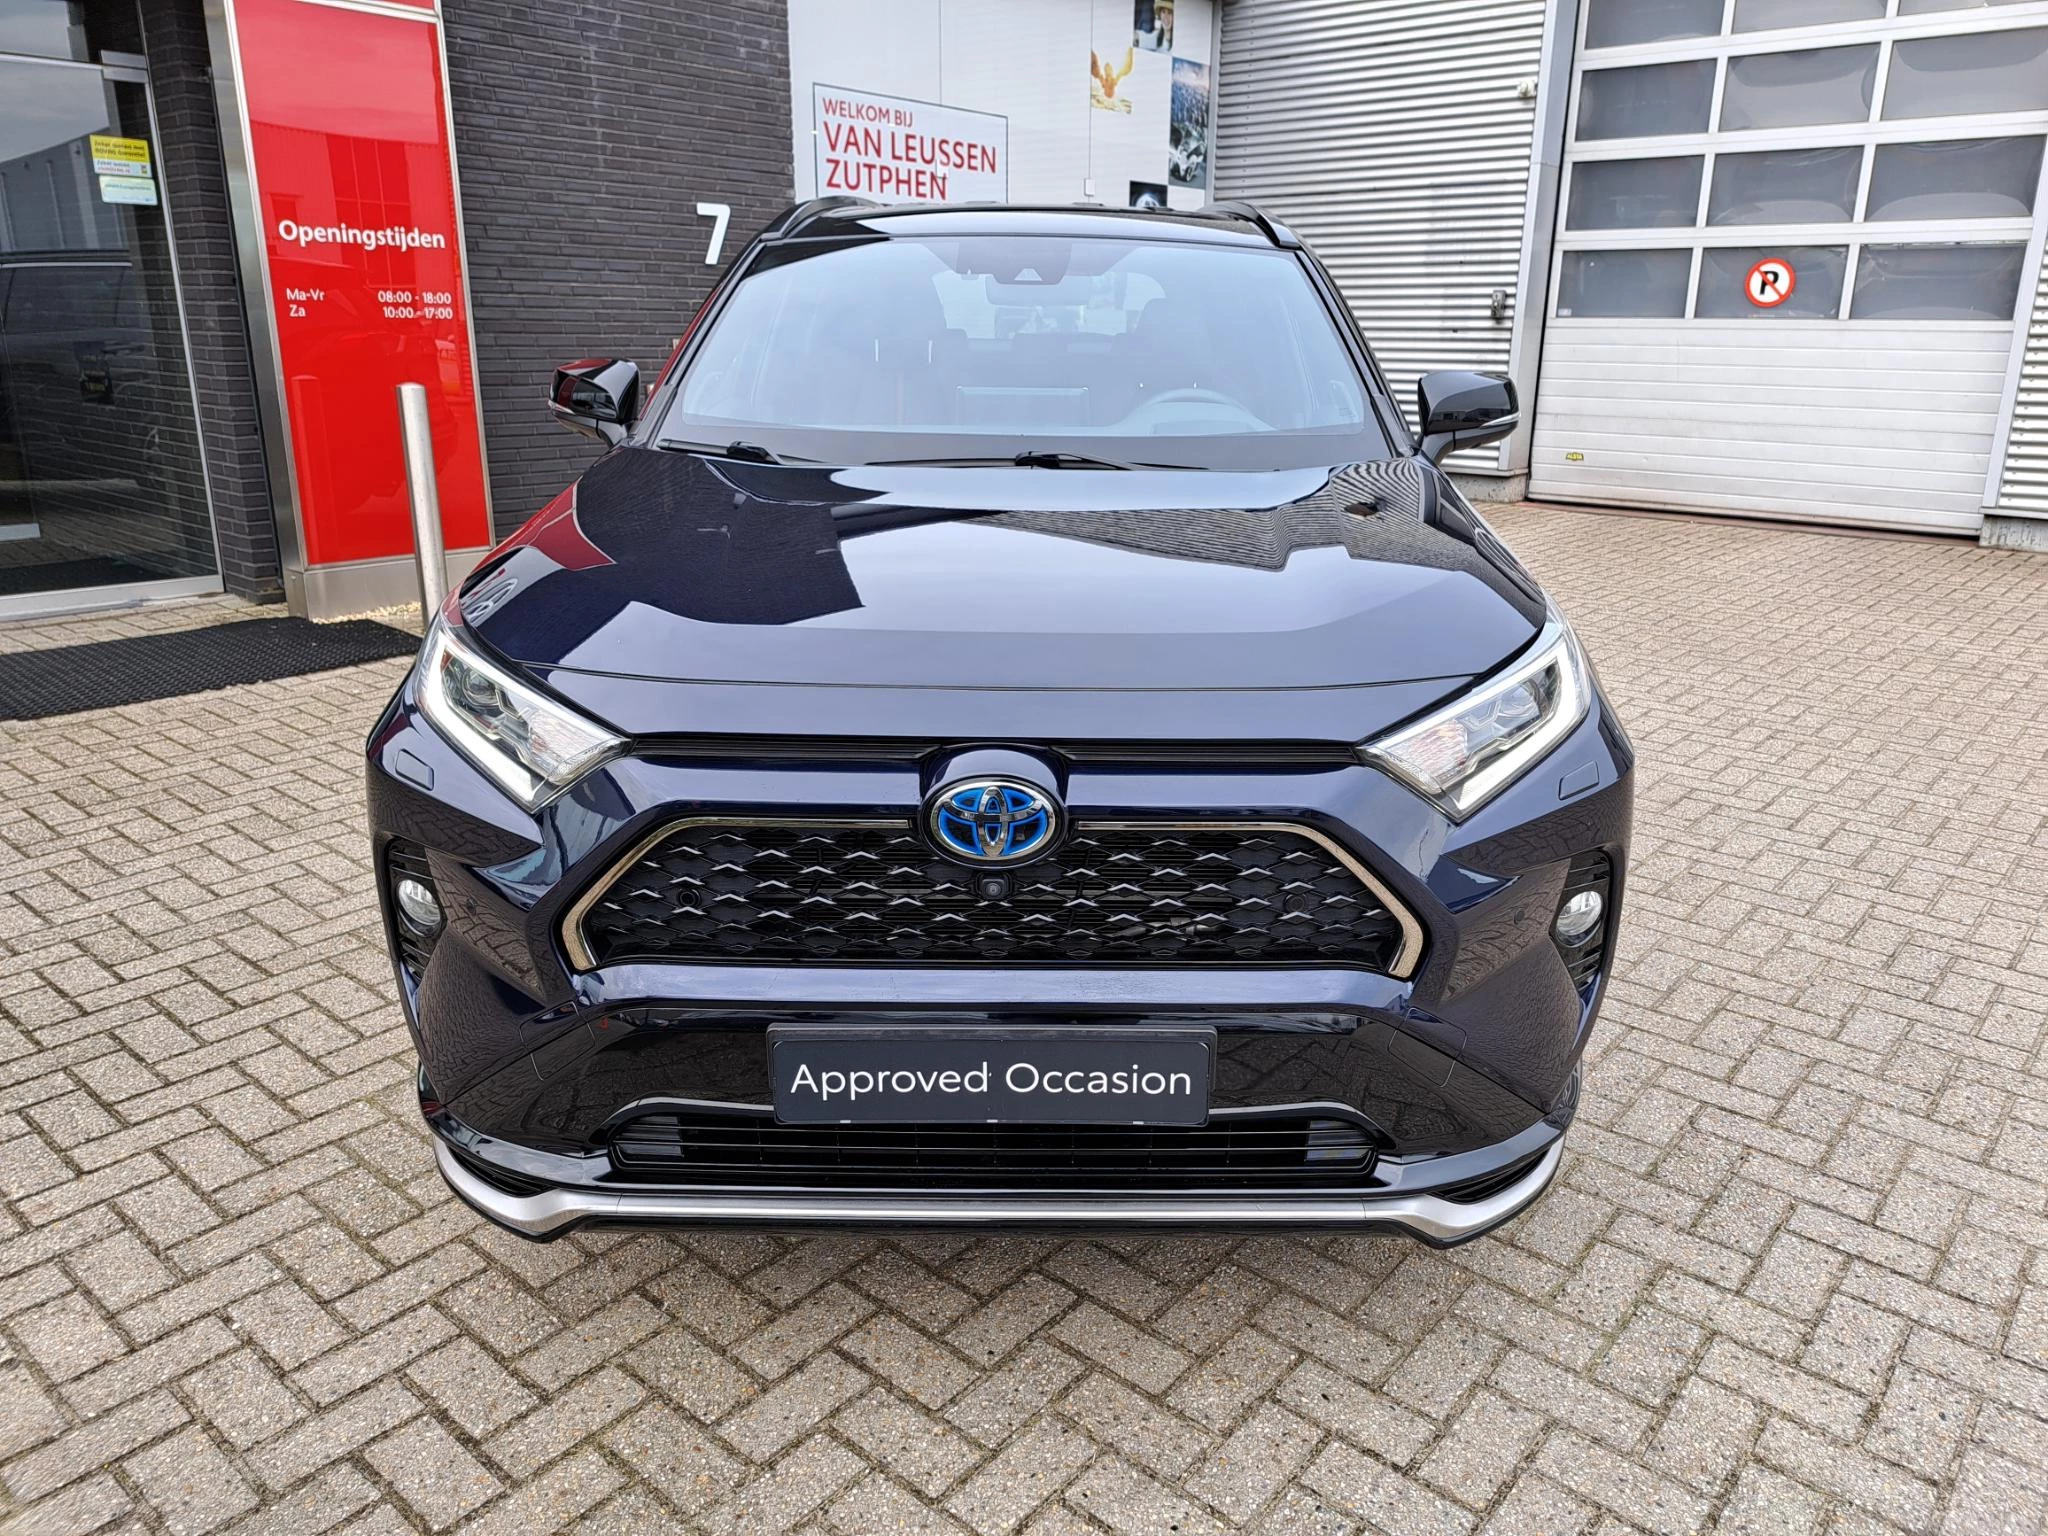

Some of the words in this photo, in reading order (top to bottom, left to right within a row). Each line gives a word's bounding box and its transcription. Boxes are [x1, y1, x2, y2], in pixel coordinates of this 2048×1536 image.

[822, 97, 890, 124] WELKOM
[895, 109, 914, 128] BIJ
[823, 121, 882, 159] VAN
[891, 131, 997, 174] LEUSSEN
[825, 158, 948, 201] ZUTPHEN
[278, 219, 446, 251] Openingstijden
[696, 202, 731, 265] 7
[286, 288, 325, 301] Ma-Vr
[377, 290, 413, 304] 08:00
[422, 292, 452, 305] 18:00
[289, 304, 307, 318] Za
[382, 306, 415, 319] 10:00
[424, 307, 454, 320] 17:00
[790, 1061, 989, 1101] Approved
[1005, 1062, 1193, 1096] Occasion
